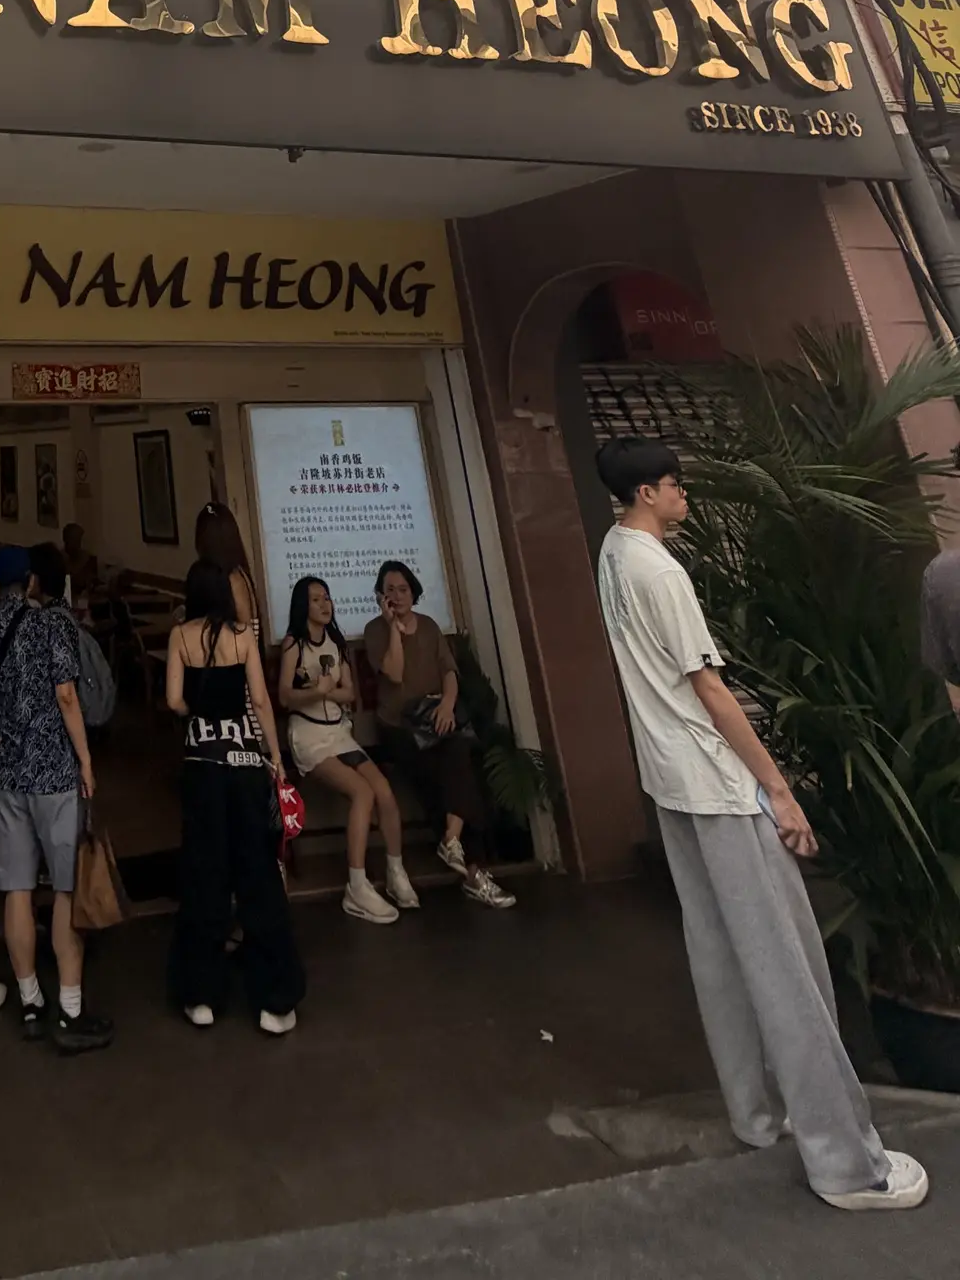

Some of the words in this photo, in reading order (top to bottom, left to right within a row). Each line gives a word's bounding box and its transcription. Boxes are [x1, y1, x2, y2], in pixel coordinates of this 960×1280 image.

[700, 101, 796, 134] SINCE
[803, 109, 863, 138] 1938
[19, 242, 192, 309] NAM
[208, 251, 436, 318] HEONG
[232, 752, 258, 764] 1990
